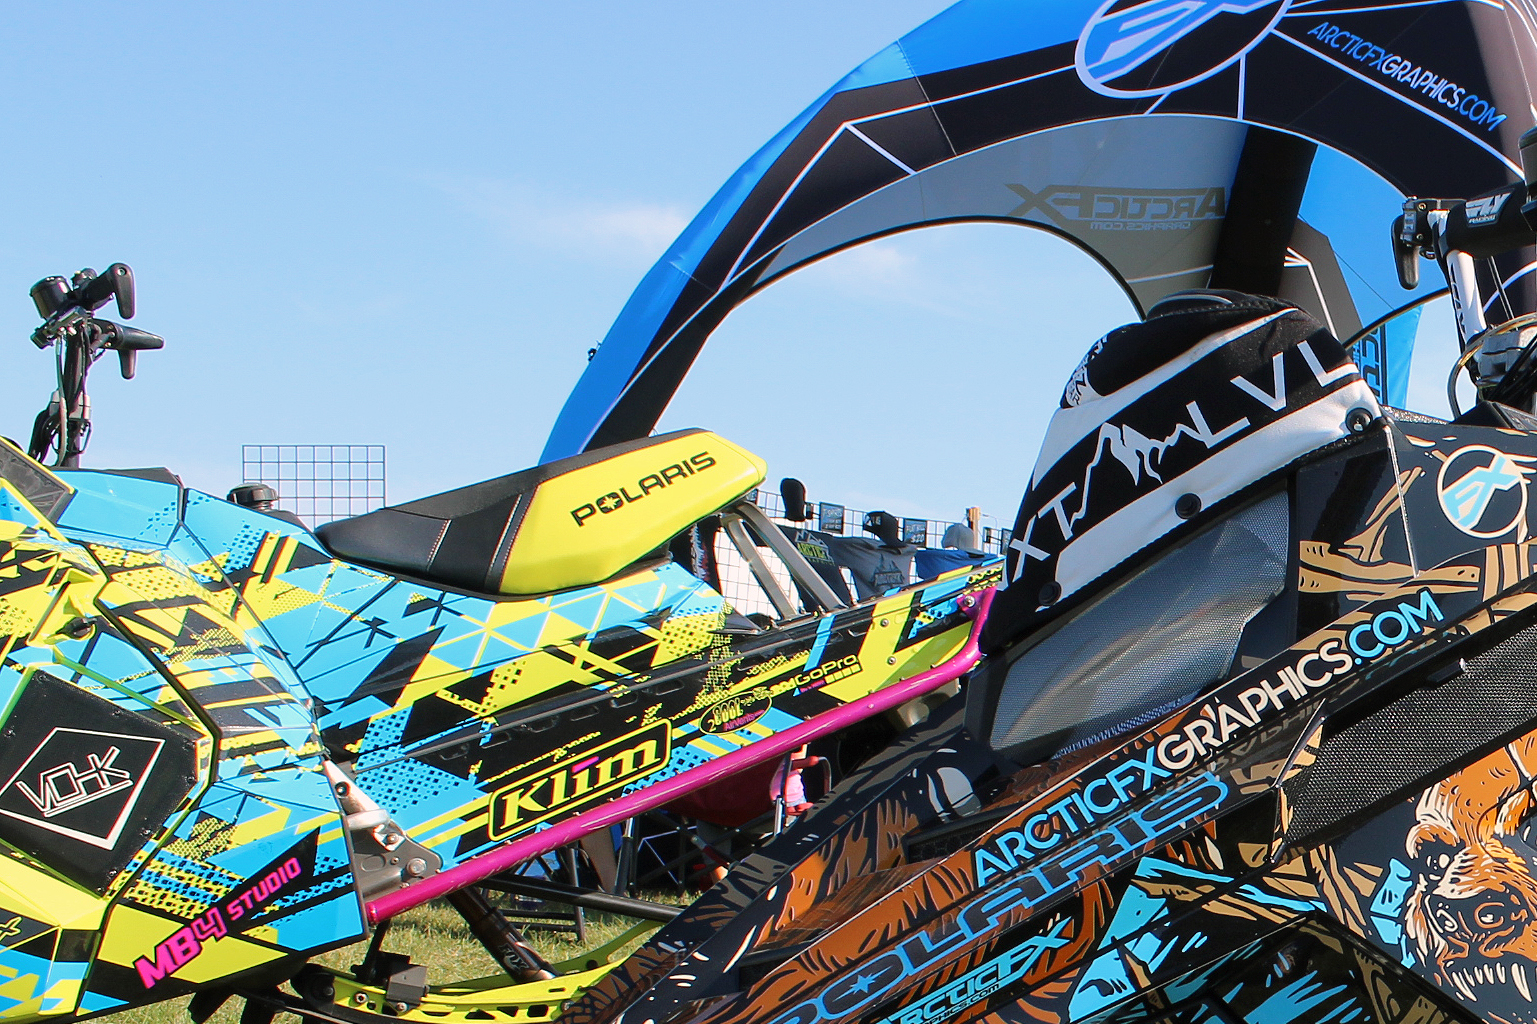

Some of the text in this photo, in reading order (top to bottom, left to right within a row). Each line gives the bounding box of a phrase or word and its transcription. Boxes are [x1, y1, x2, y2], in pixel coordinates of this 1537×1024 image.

[1307, 21, 1508, 132] ARCTICFXGRAPHICS.COM
[1186, 340, 1360, 449] LVL
[570, 451, 717, 527] POLARIS
[795, 654, 859, 686] GoPro
[972, 588, 1444, 887] ARCTICFXGRAPHICS.COM
[226, 857, 302, 921] STUDIO
